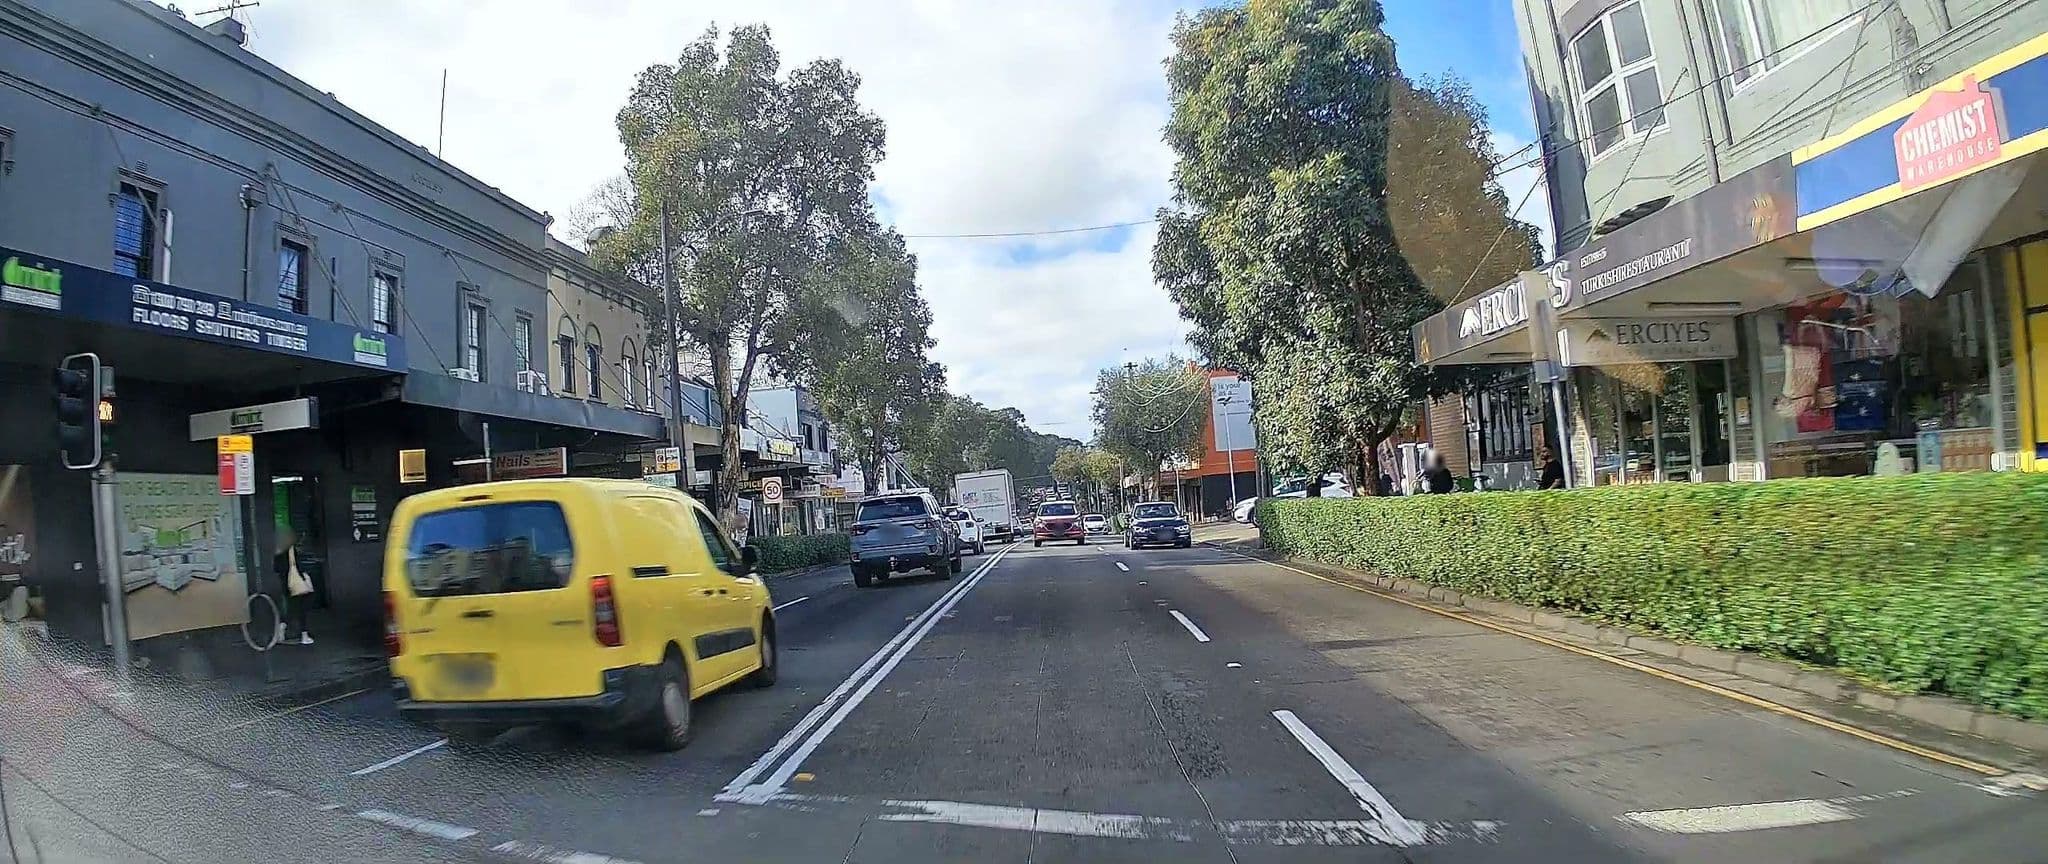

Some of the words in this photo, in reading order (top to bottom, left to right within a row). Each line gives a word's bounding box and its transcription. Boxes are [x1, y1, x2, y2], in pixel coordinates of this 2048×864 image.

[1901, 98, 1987, 162] CHEMIST
[1906, 137, 1995, 181] WAREHOUSE
[133, 306, 189, 331] FLOORS
[195, 319, 260, 344] SHUTTERS
[265, 331, 308, 352] TIMBER
[1616, 321, 1711, 345] ERCIYES
[496, 454, 530, 468] Nails
[766, 486, 779, 495] 50
